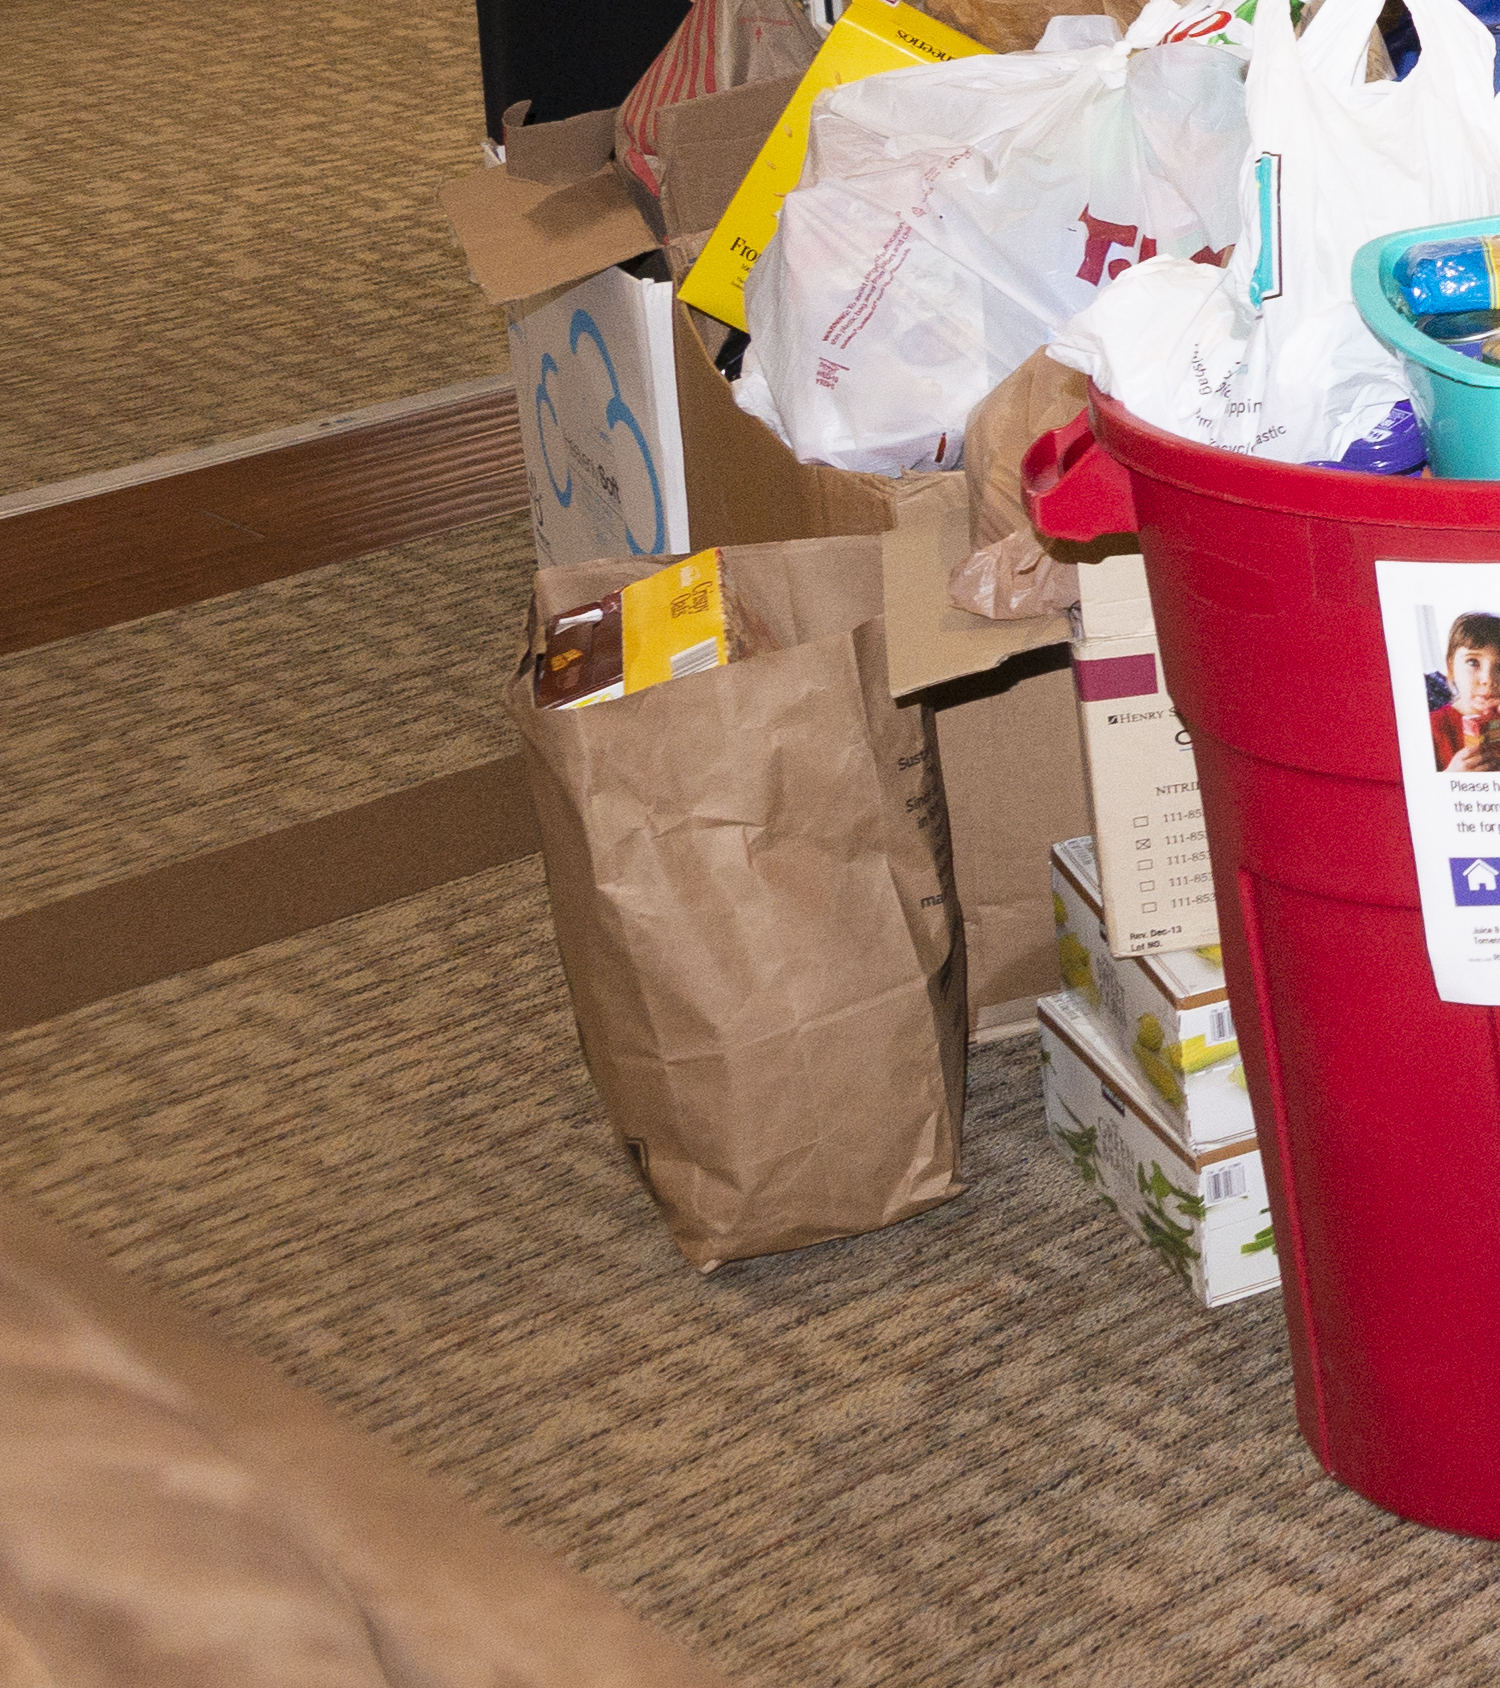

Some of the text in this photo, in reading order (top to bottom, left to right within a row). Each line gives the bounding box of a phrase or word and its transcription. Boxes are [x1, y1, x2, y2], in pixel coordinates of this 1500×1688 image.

[1120, 710, 1164, 724] HENRY
[1450, 780, 1489, 793] Please
[1454, 801, 1474, 813] the
[1457, 821, 1476, 833] the
[1151, 925, 1182, 938] Dec-13
